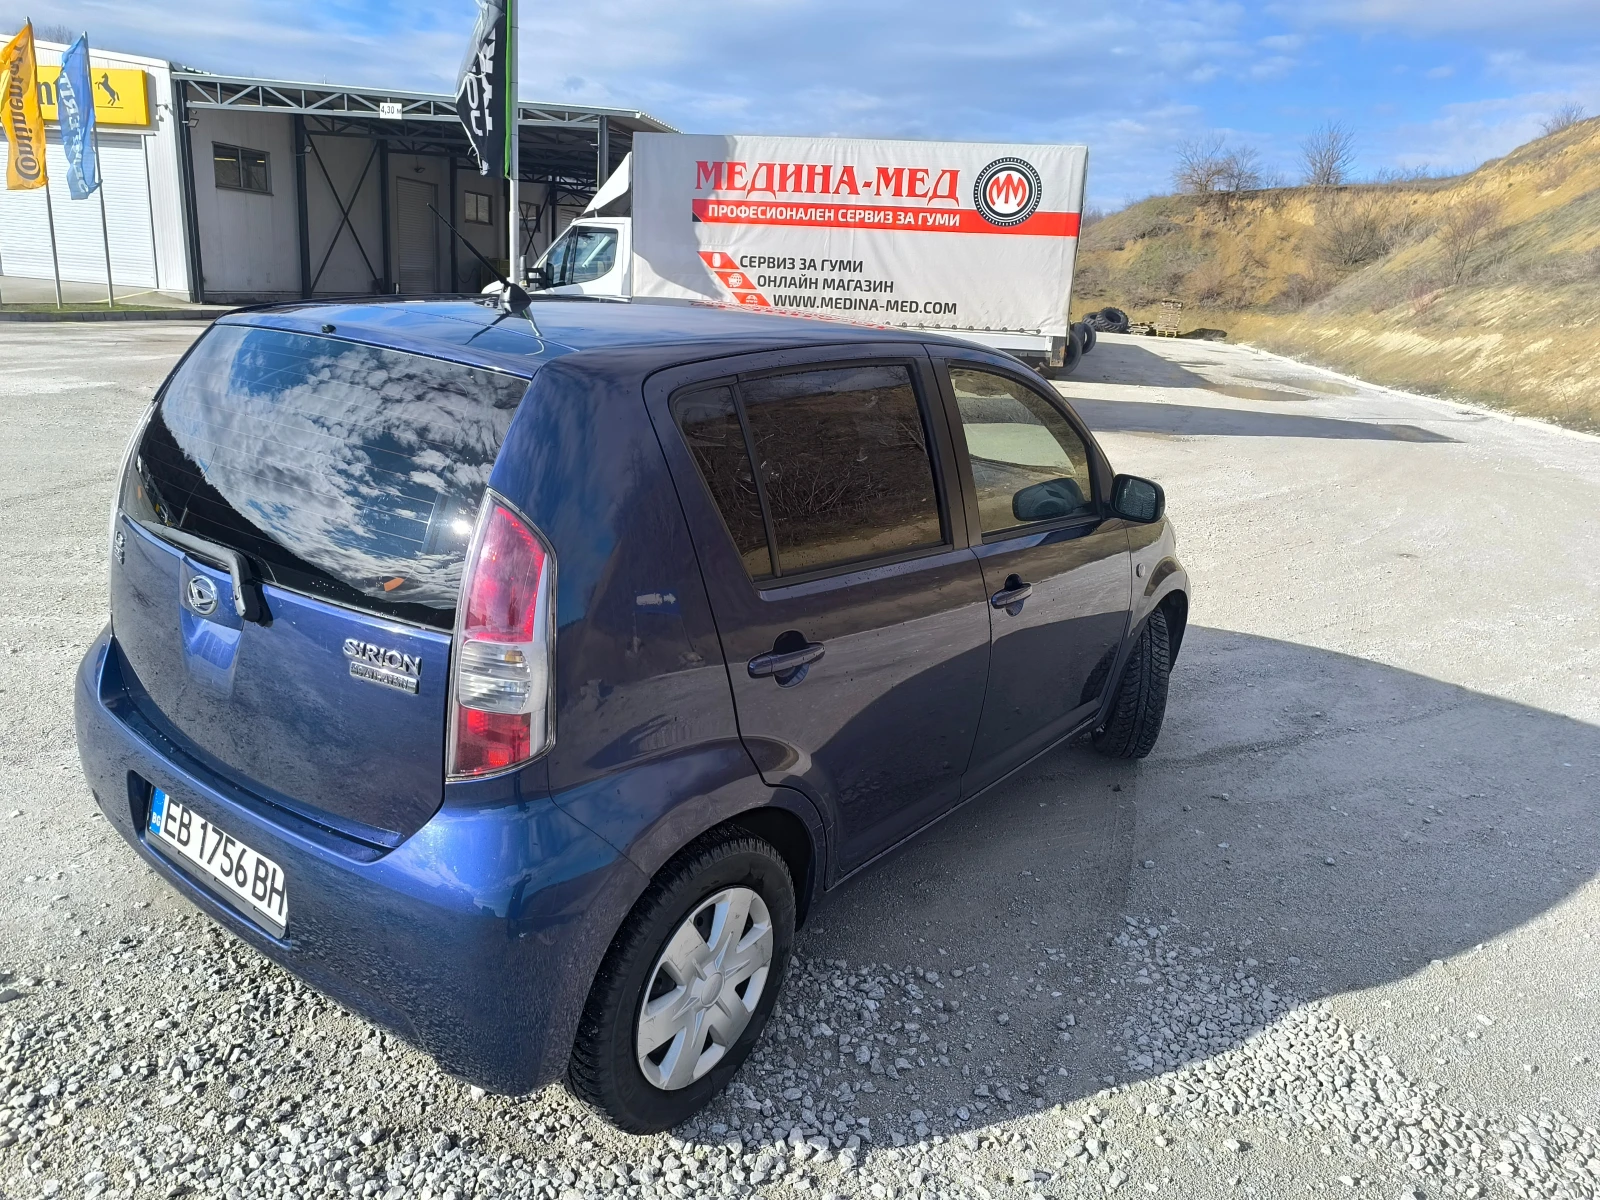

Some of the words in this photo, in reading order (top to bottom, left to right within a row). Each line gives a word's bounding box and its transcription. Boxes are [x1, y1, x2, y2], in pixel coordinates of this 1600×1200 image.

[381, 105, 395, 116] 4,30
[695, 160, 960, 207] МЕДИНА-МЕД
[708, 204, 835, 222] ПРОФЕСИОНАЛЕН
[838, 209, 893, 225] СЕРВИЗ
[896, 212, 916, 225] ЗА
[918, 213, 961, 227] ГУМИ
[740, 255, 796, 270] СЕРВИЗ
[798, 257, 818, 271] ЗА
[821, 258, 863, 273] ГУМИ
[757, 273, 819, 289] ОНЛАЙН
[823, 278, 894, 293] МАГАЗИН
[773, 294, 957, 315] WWW.MEDINA-MED.COM
[342, 638, 422, 676] SIRION
[152, 812, 161, 826] BG
[163, 799, 193, 847] EB
[199, 821, 248, 888] 1756
[251, 857, 285, 916] BH
